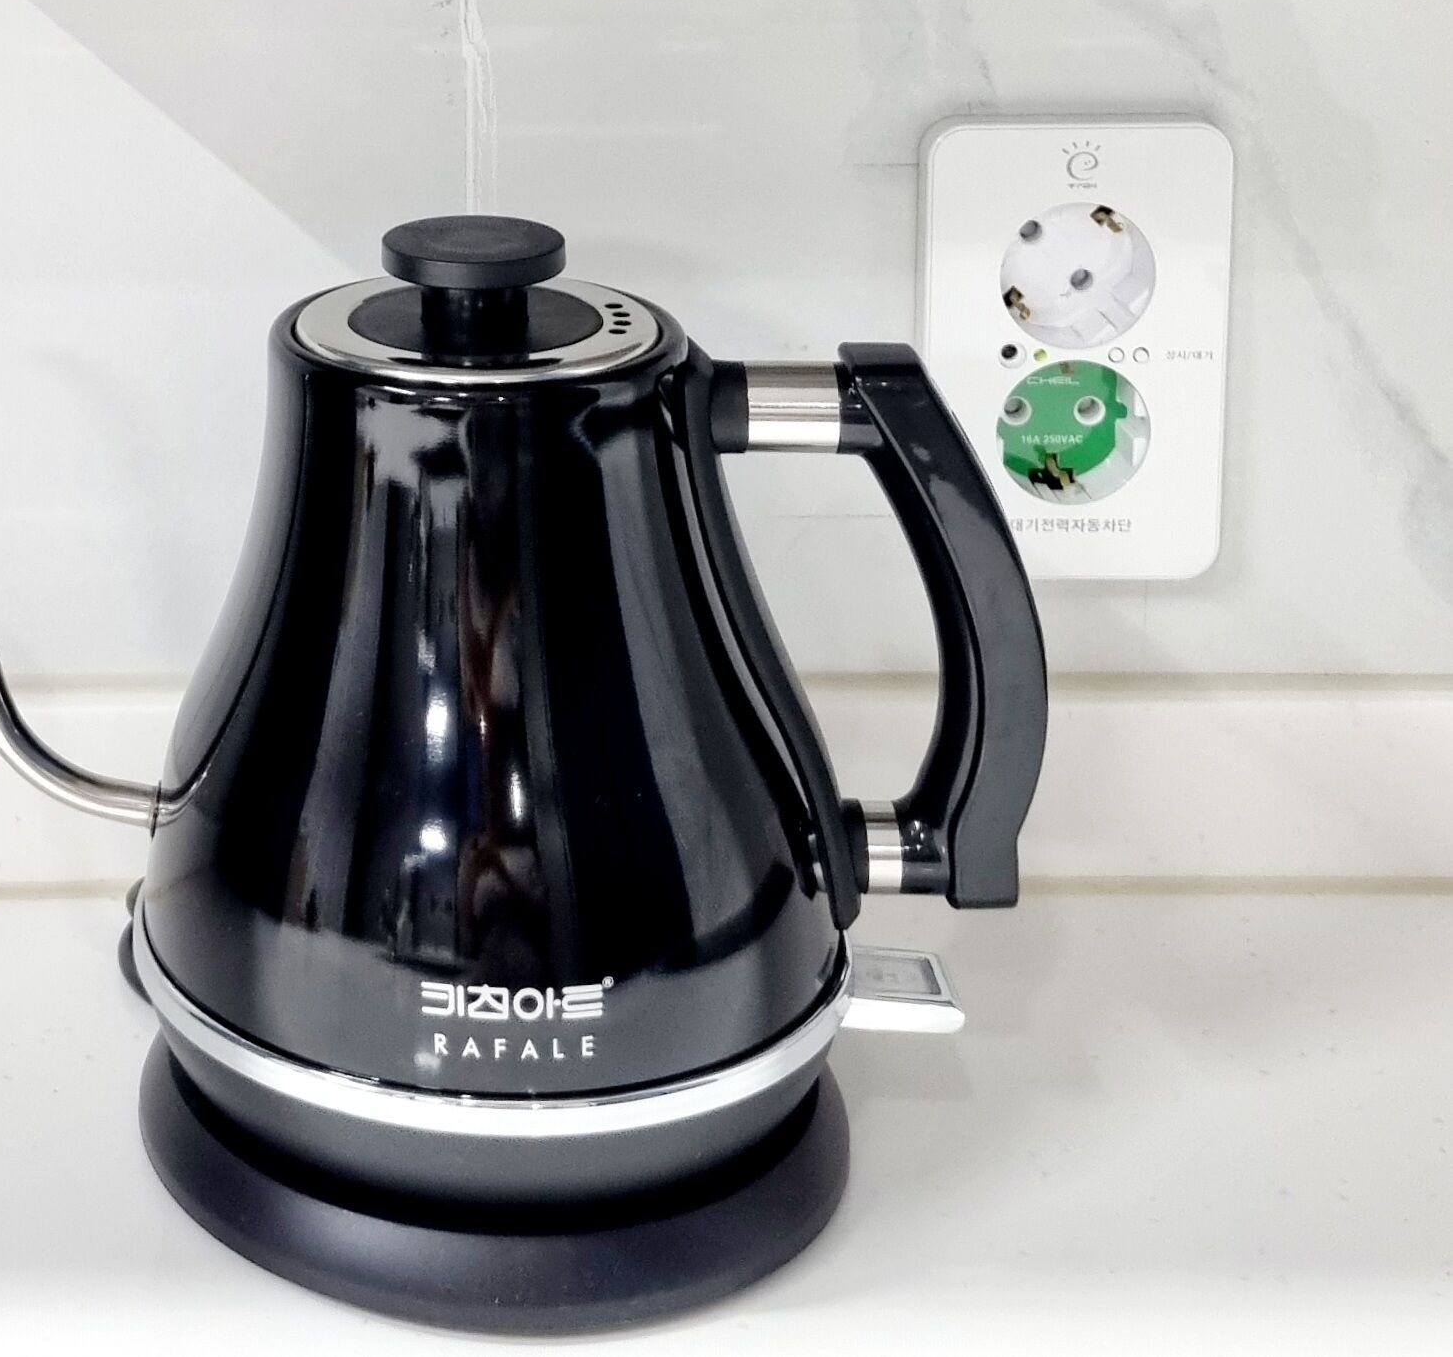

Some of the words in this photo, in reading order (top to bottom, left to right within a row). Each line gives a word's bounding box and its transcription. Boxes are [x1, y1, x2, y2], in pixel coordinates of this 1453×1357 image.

[1021, 434, 1040, 444] 16A
[1044, 434, 1083, 444] 250VAC
[1010, 518, 1131, 533] 대기전력자동차단
[433, 1032, 595, 1060] RAFALE
